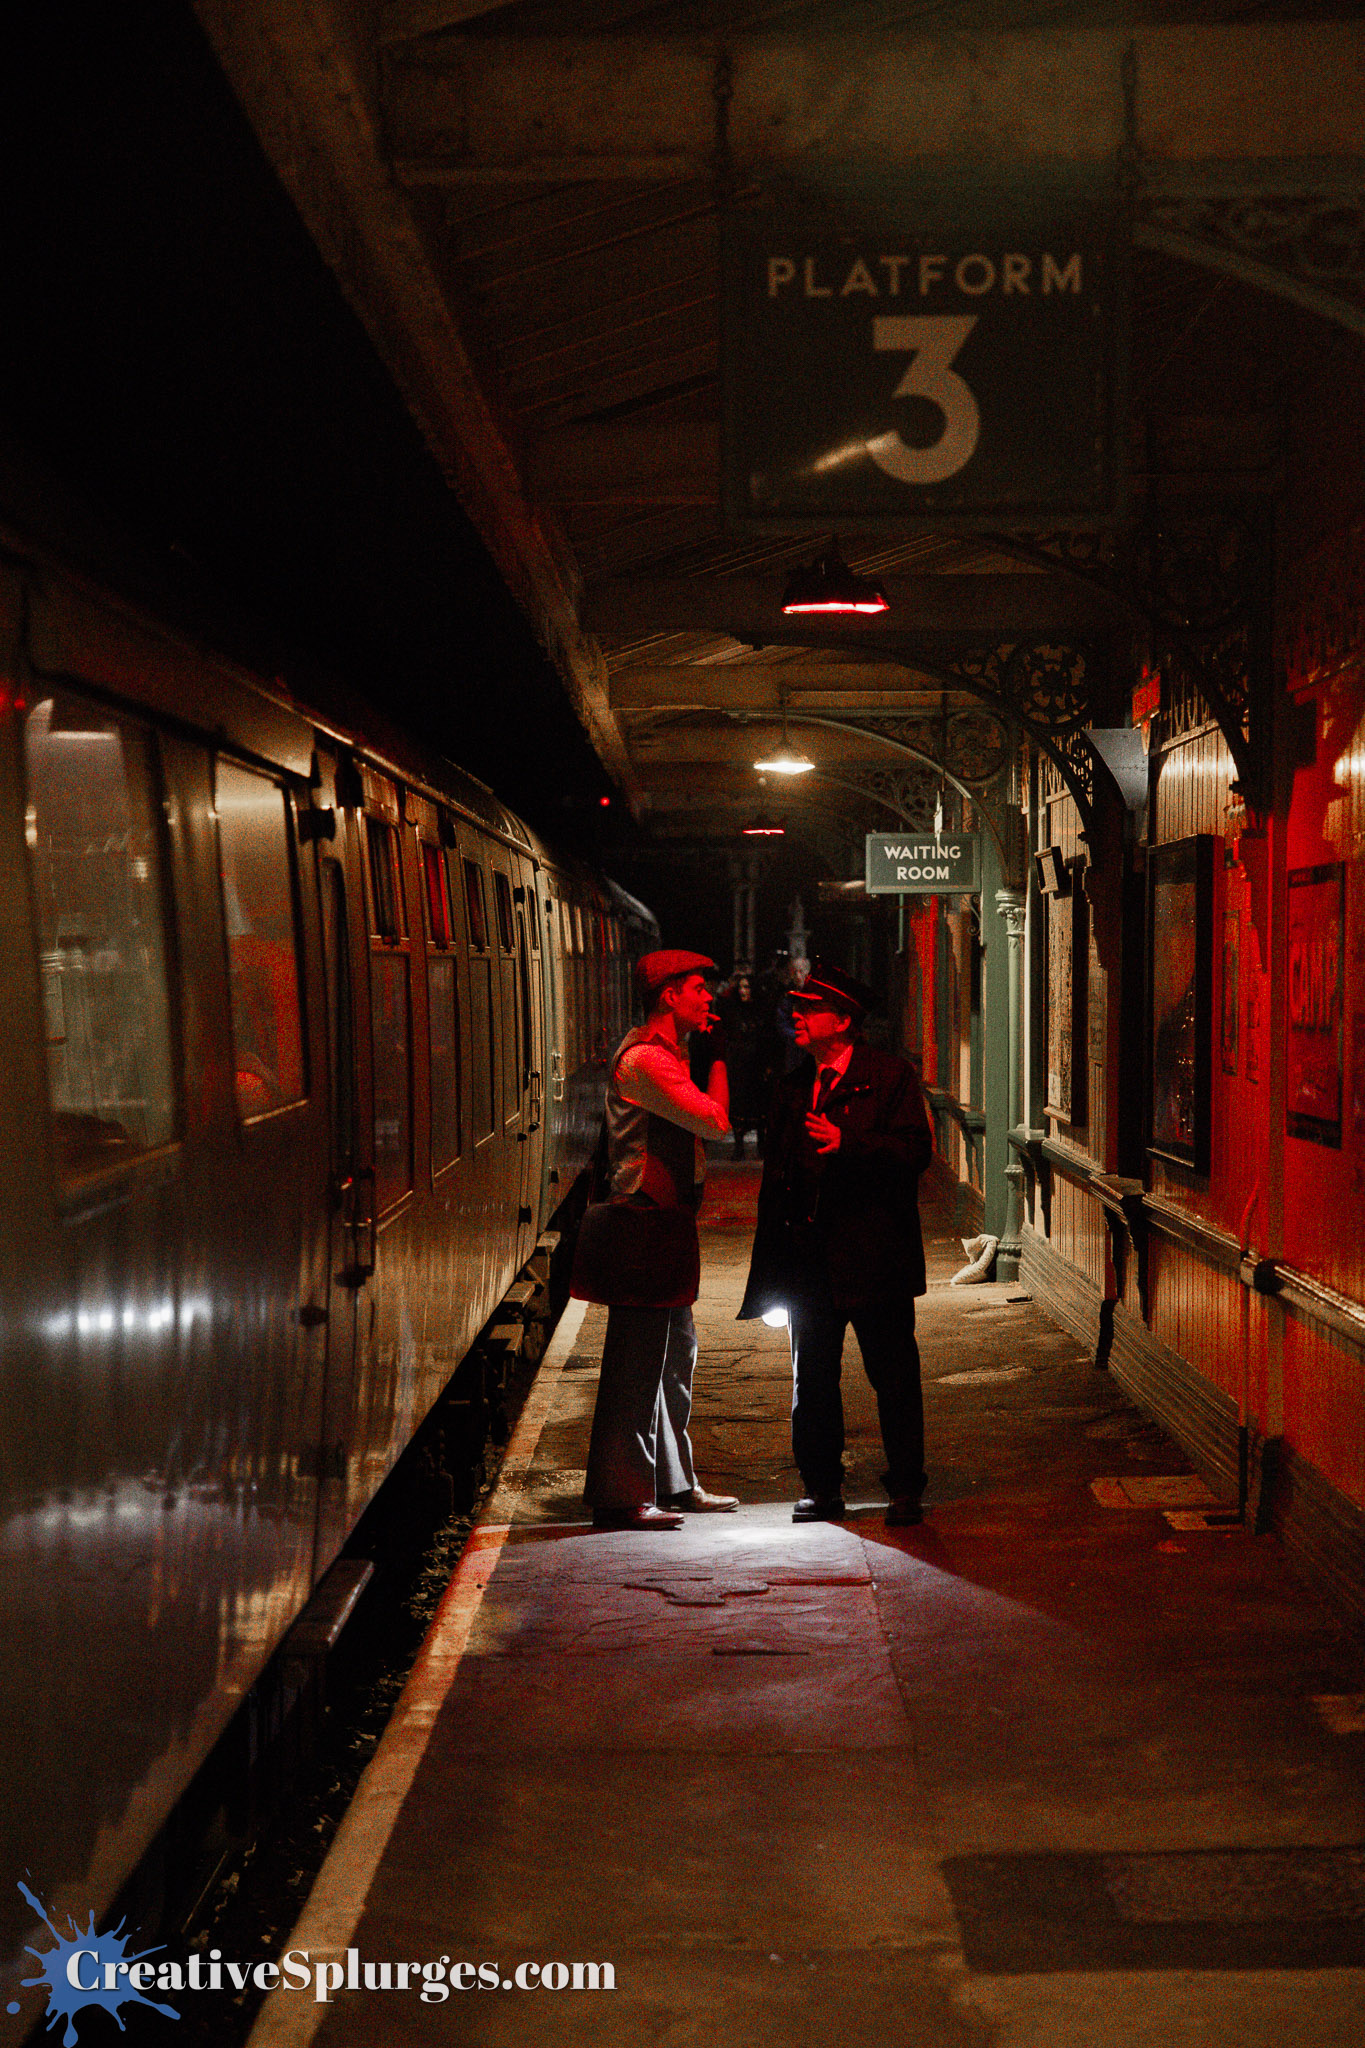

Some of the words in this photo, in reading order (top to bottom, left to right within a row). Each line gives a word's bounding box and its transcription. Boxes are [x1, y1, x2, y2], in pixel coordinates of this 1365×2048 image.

[767, 253, 1083, 297] PLATFORM
[867, 314, 980, 484] 3
[883, 845, 962, 859] WAITING
[896, 865, 950, 880] ROOM
